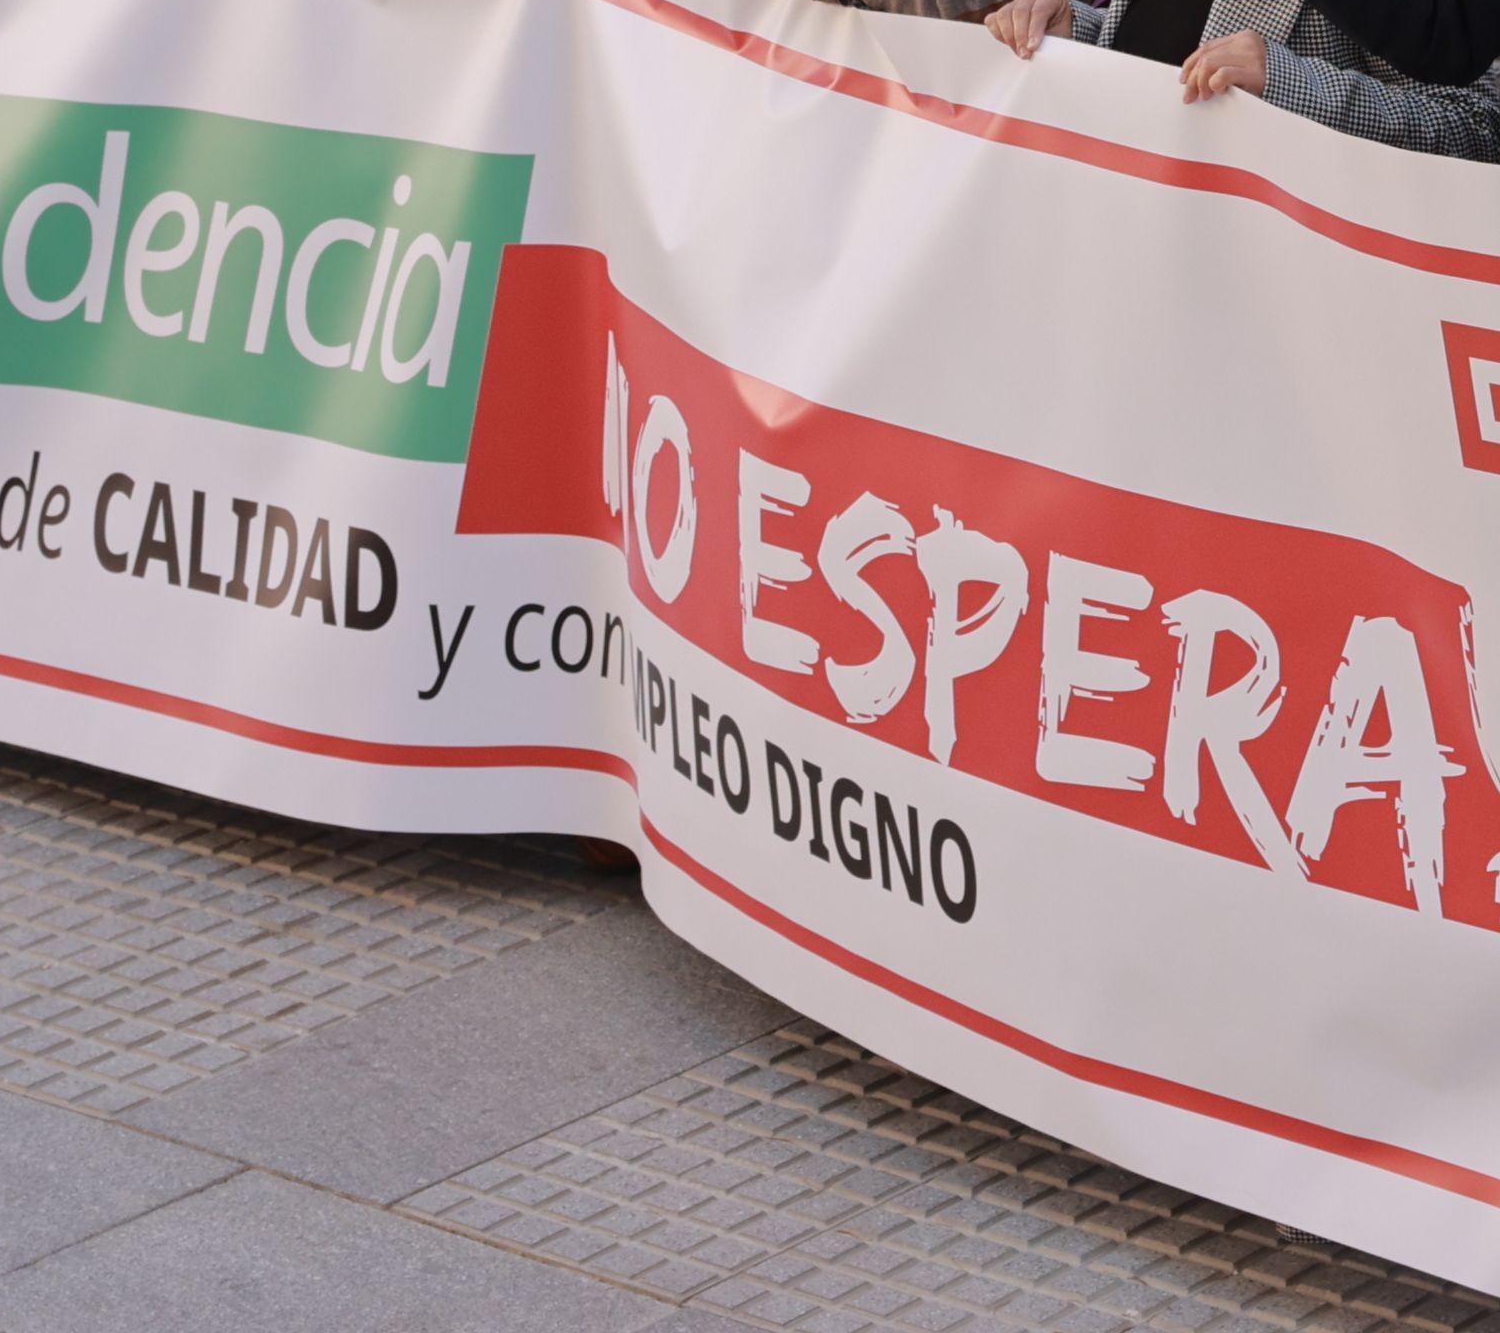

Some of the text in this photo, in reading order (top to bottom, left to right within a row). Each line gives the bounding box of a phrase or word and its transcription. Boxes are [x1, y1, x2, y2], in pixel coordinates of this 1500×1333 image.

[93, 471, 400, 633] CALIDAD
[417, 602, 475, 700] y
[503, 601, 625, 686] con
[765, 739, 977, 924] DIGNO
